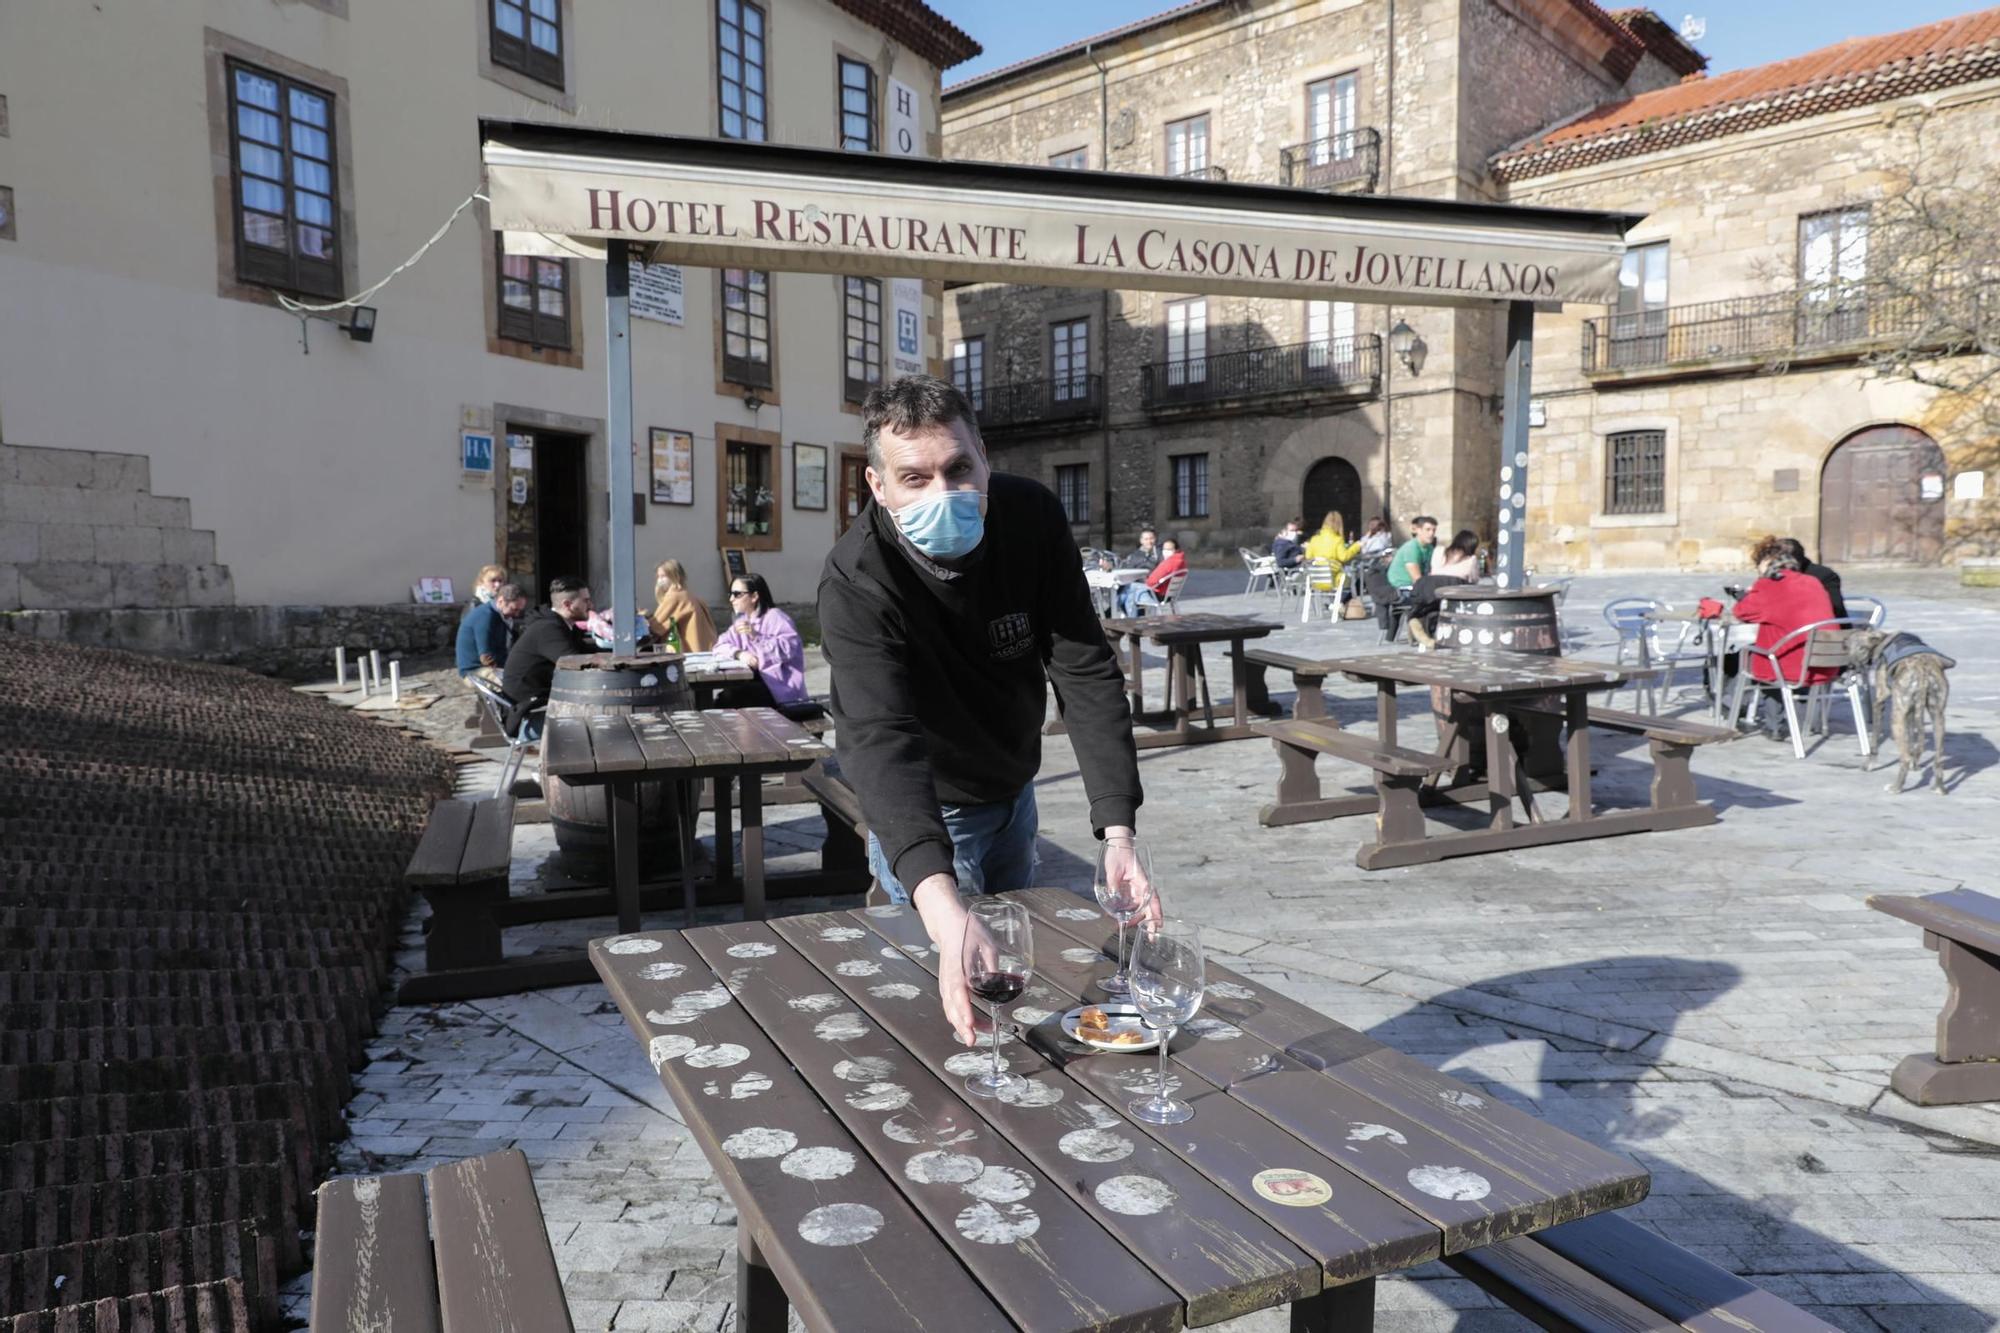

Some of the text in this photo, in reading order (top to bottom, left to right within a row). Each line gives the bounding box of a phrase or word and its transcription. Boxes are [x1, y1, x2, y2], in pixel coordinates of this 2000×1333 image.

[585, 188, 1560, 297] HOTEL RESTAURANTE LA CASONA DE JOVELLANOS
